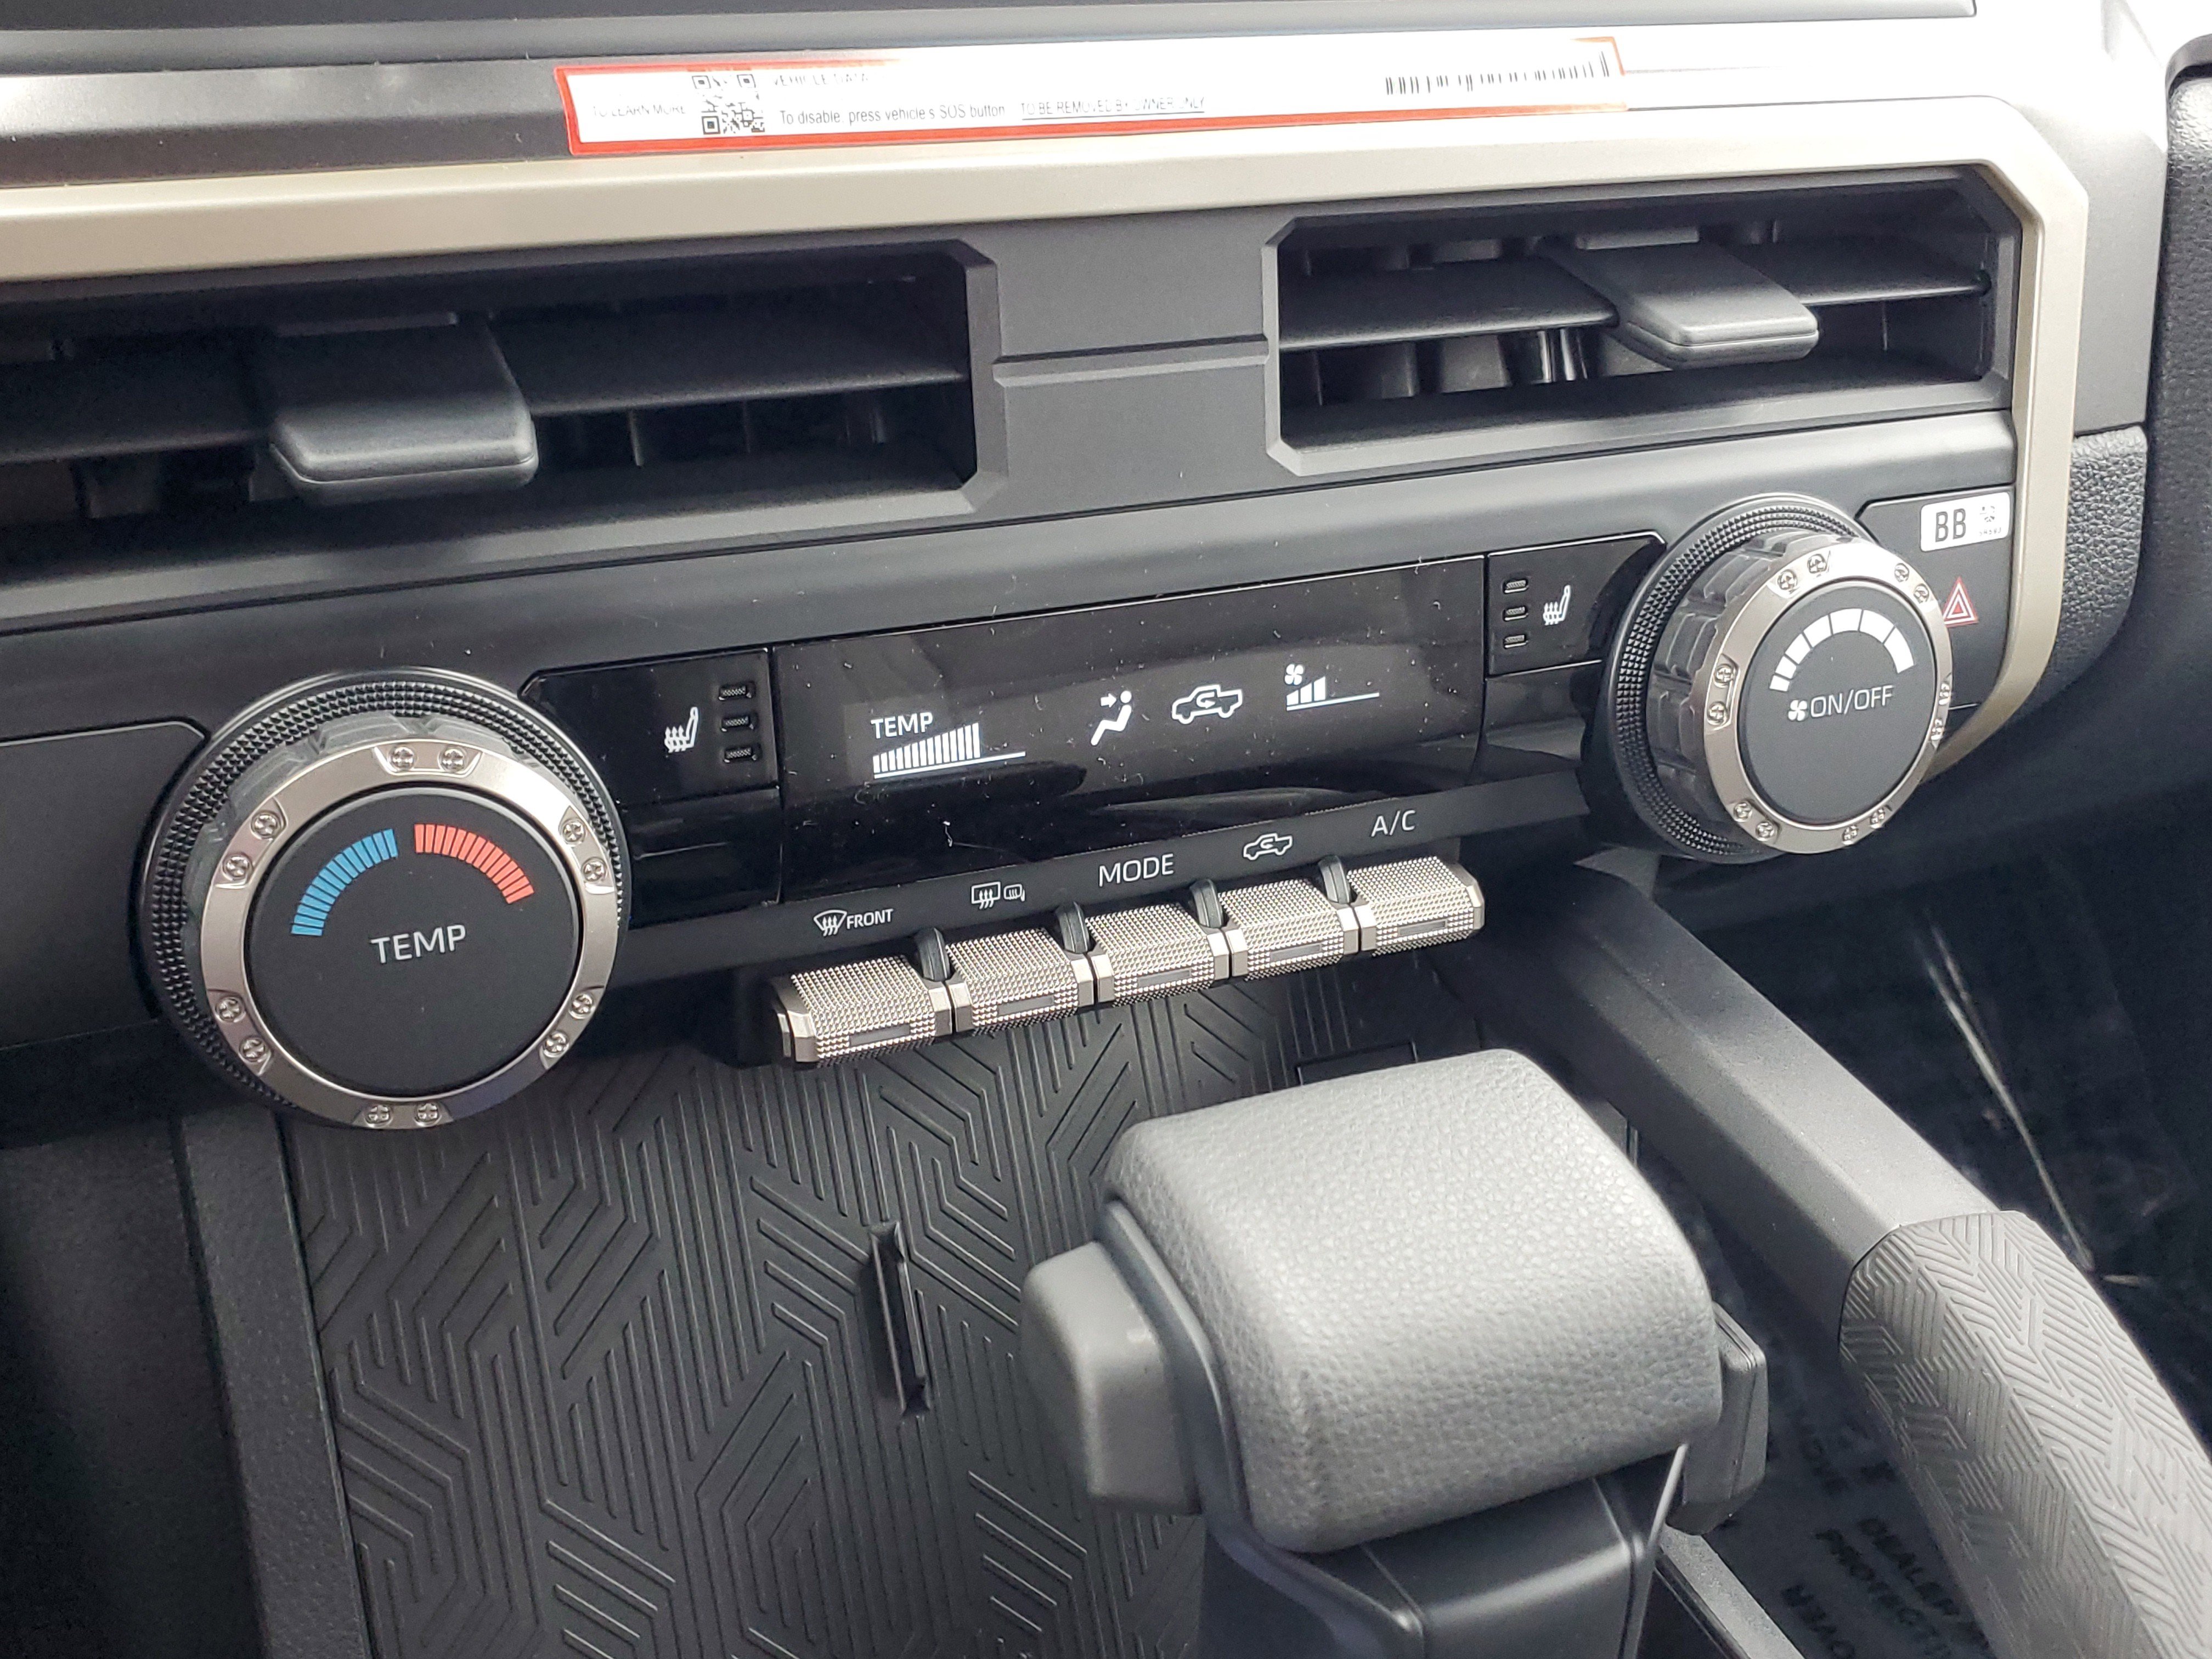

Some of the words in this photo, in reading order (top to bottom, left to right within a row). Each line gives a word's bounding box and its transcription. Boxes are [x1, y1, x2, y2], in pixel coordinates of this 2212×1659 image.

[779, 110, 794, 125] To
[849, 110, 881, 127] press
[939, 103, 966, 119] SOS
[969, 103, 1005, 118] button
[1021, 103, 1036, 115] TO
[1039, 101, 1054, 115] BE
[1057, 99, 1113, 114] REMOVED
[1936, 508, 1967, 543] BB
[1811, 685, 1894, 718] ON/OFF
[871, 712, 934, 740] TEMP
[1372, 810, 1416, 838] A/C
[1099, 854, 1175, 888] MODE
[847, 909, 894, 930] FRONT
[371, 925, 467, 964] TEMP
